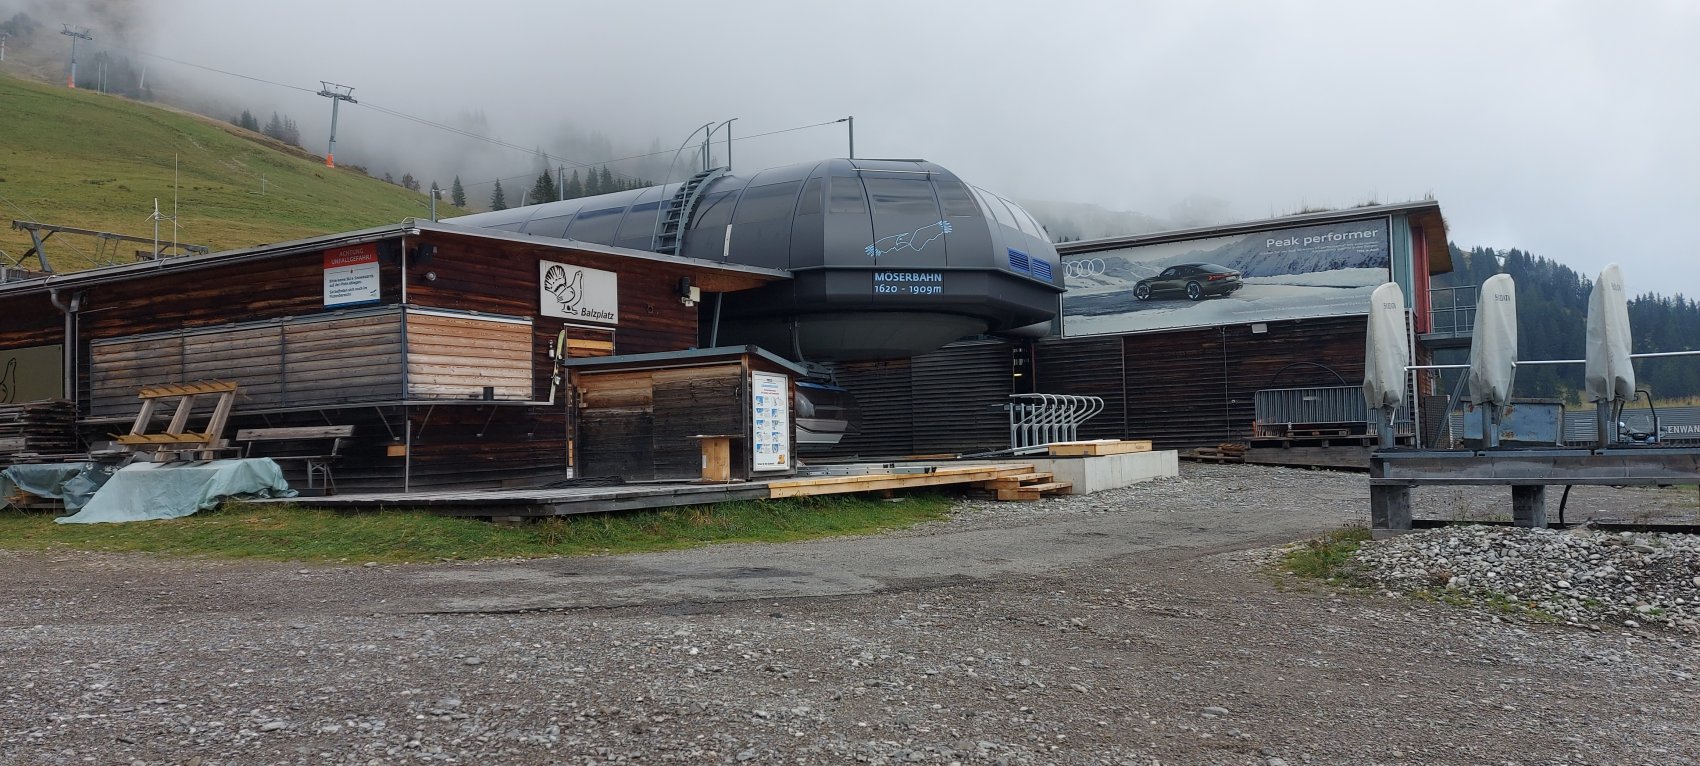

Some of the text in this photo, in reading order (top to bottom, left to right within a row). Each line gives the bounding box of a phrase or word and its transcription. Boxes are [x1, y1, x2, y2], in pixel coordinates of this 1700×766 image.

[1266, 237, 1300, 248] Peak
[1303, 229, 1379, 246] performer
[339, 248, 364, 257] ACHTUNG
[874, 271, 942, 282] MÖSERBAHN
[874, 284, 898, 293] 1620
[909, 285, 942, 295] 1909m
[580, 307, 615, 320] Balzplatz
